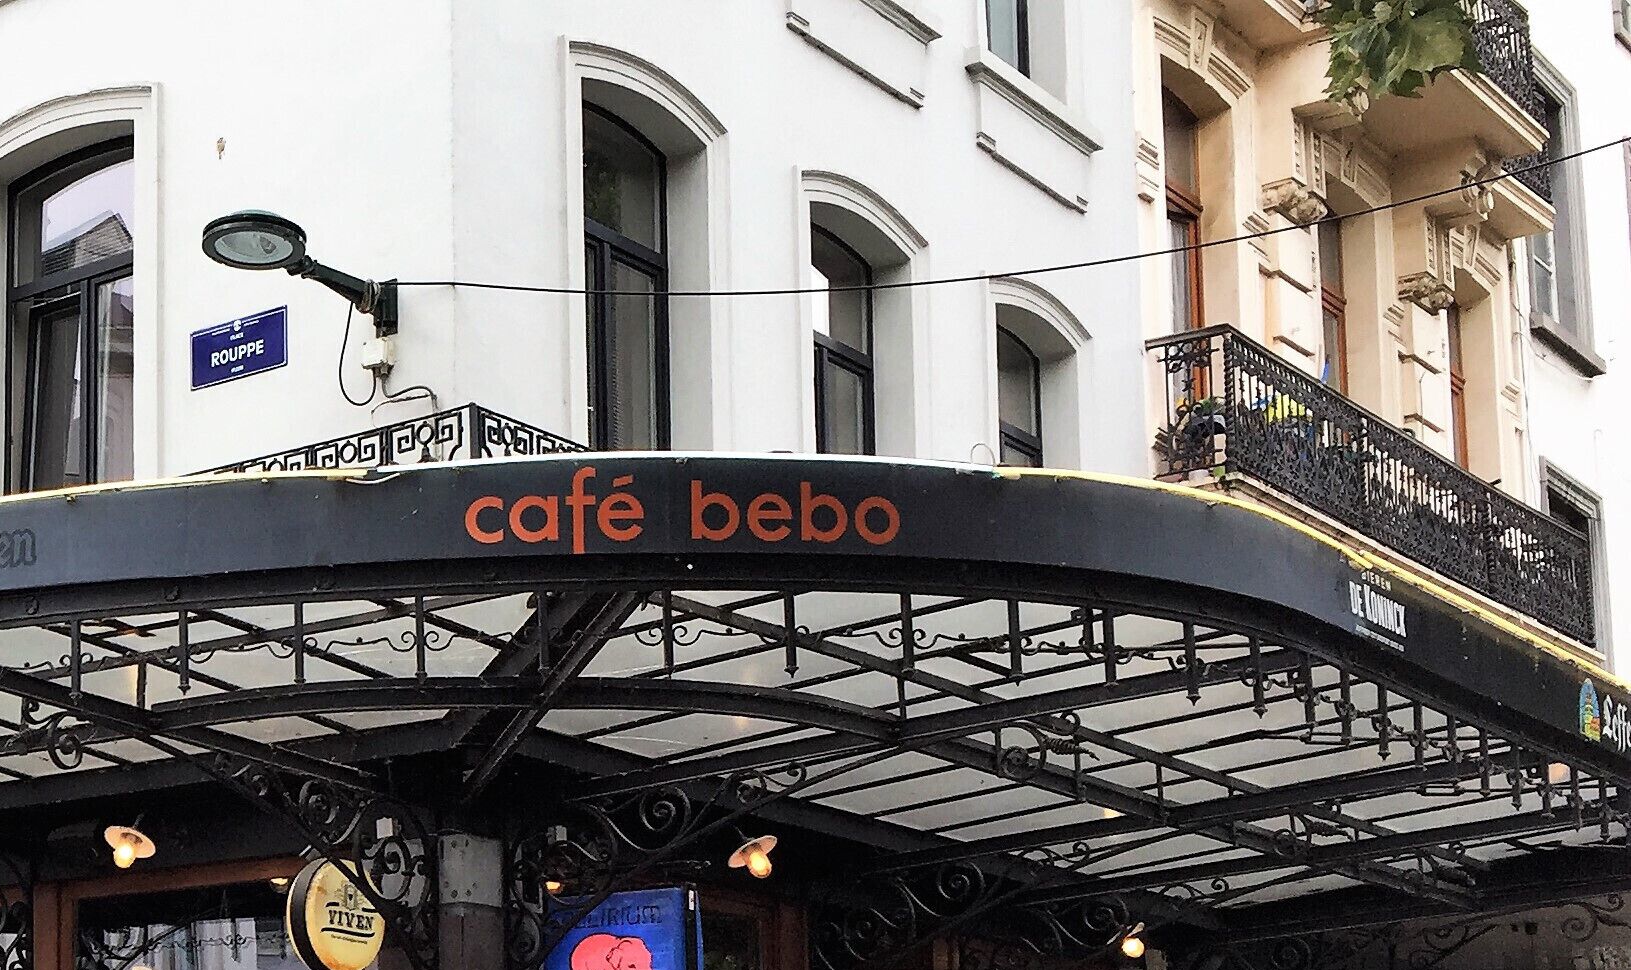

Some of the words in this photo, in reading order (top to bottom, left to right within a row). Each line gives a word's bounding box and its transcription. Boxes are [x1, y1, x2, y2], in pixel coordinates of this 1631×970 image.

[211, 339, 264, 368] ROUPPE
[464, 466, 646, 555] café
[691, 479, 901, 546] bebo
[1349, 580, 1364, 618] DE
[329, 910, 374, 930] VIVEN
